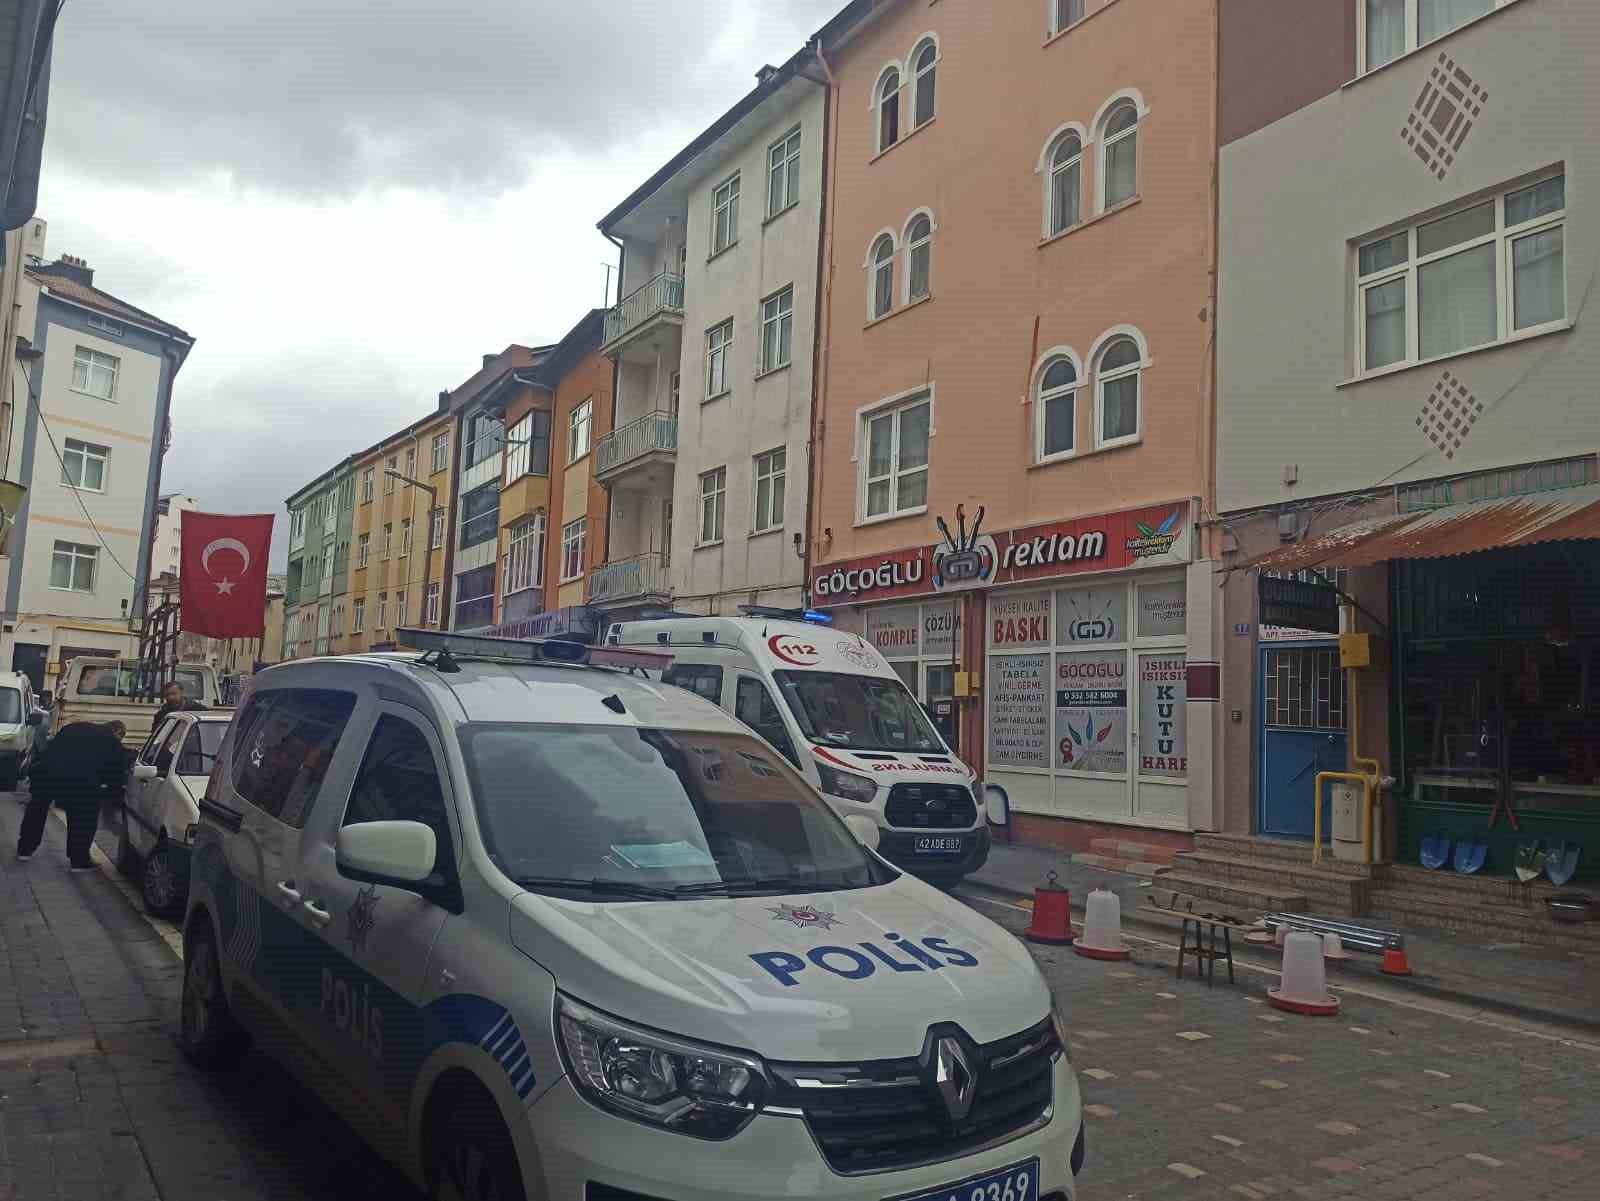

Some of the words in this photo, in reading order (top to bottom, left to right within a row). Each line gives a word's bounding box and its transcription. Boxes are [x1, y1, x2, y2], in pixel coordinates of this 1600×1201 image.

[1002, 531, 1105, 569] reklam
[815, 559, 922, 597] GÖÇOĞLU
[993, 616, 1048, 643] BASKI
[781, 644, 818, 655] 112
[1156, 685, 1175, 754] KUTU
[919, 838, 930, 849] 42
[749, 932, 979, 987] POLİS
